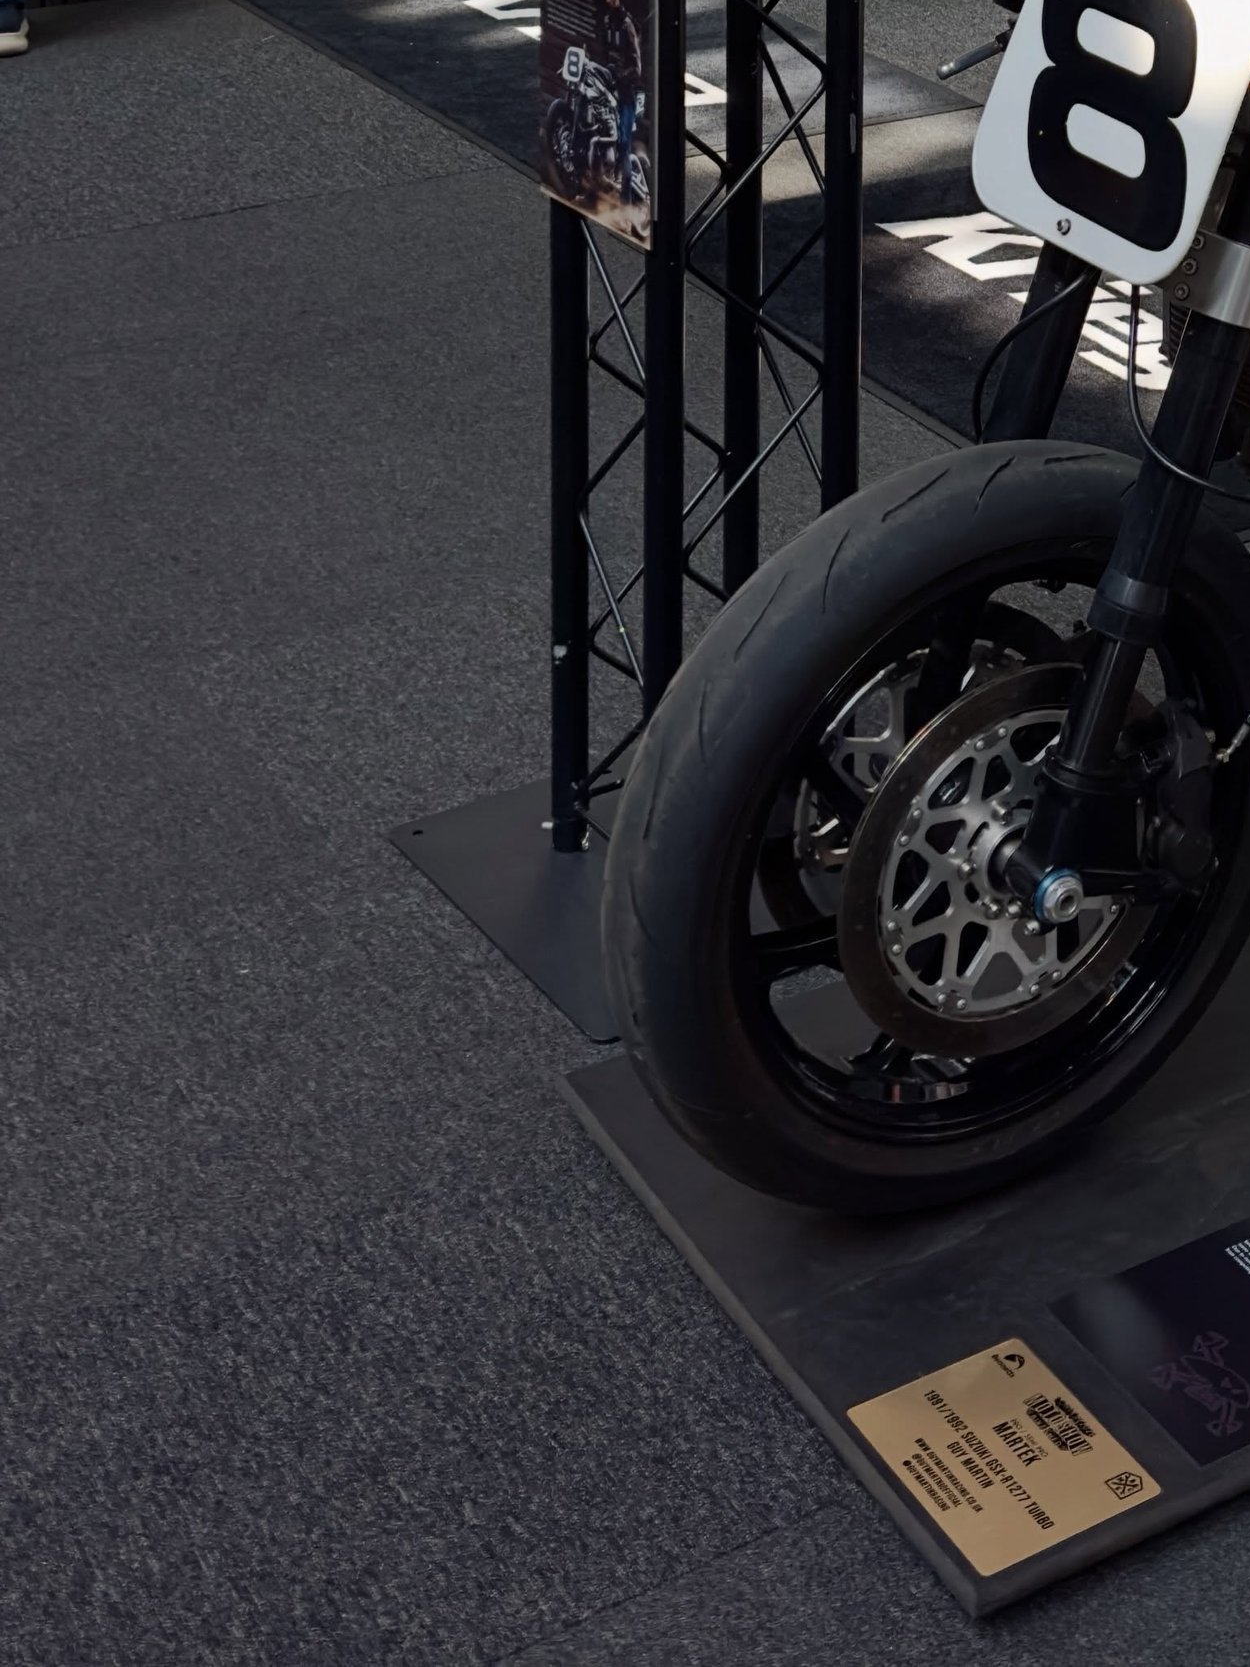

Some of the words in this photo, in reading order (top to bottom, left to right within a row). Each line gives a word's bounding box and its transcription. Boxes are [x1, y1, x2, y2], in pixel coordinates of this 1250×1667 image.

[568, 49, 580, 79] 8
[924, 1389, 968, 1432] 1991/1992
[960, 1431, 992, 1460] SUZUKI
[985, 1458, 1031, 1502] GSX-R1277
[1024, 1501, 1054, 1529] TURBO
[946, 1441, 969, 1458] GUY
[960, 1457, 994, 1489] MARTIN
[992, 1421, 1041, 1466] MARTEK
